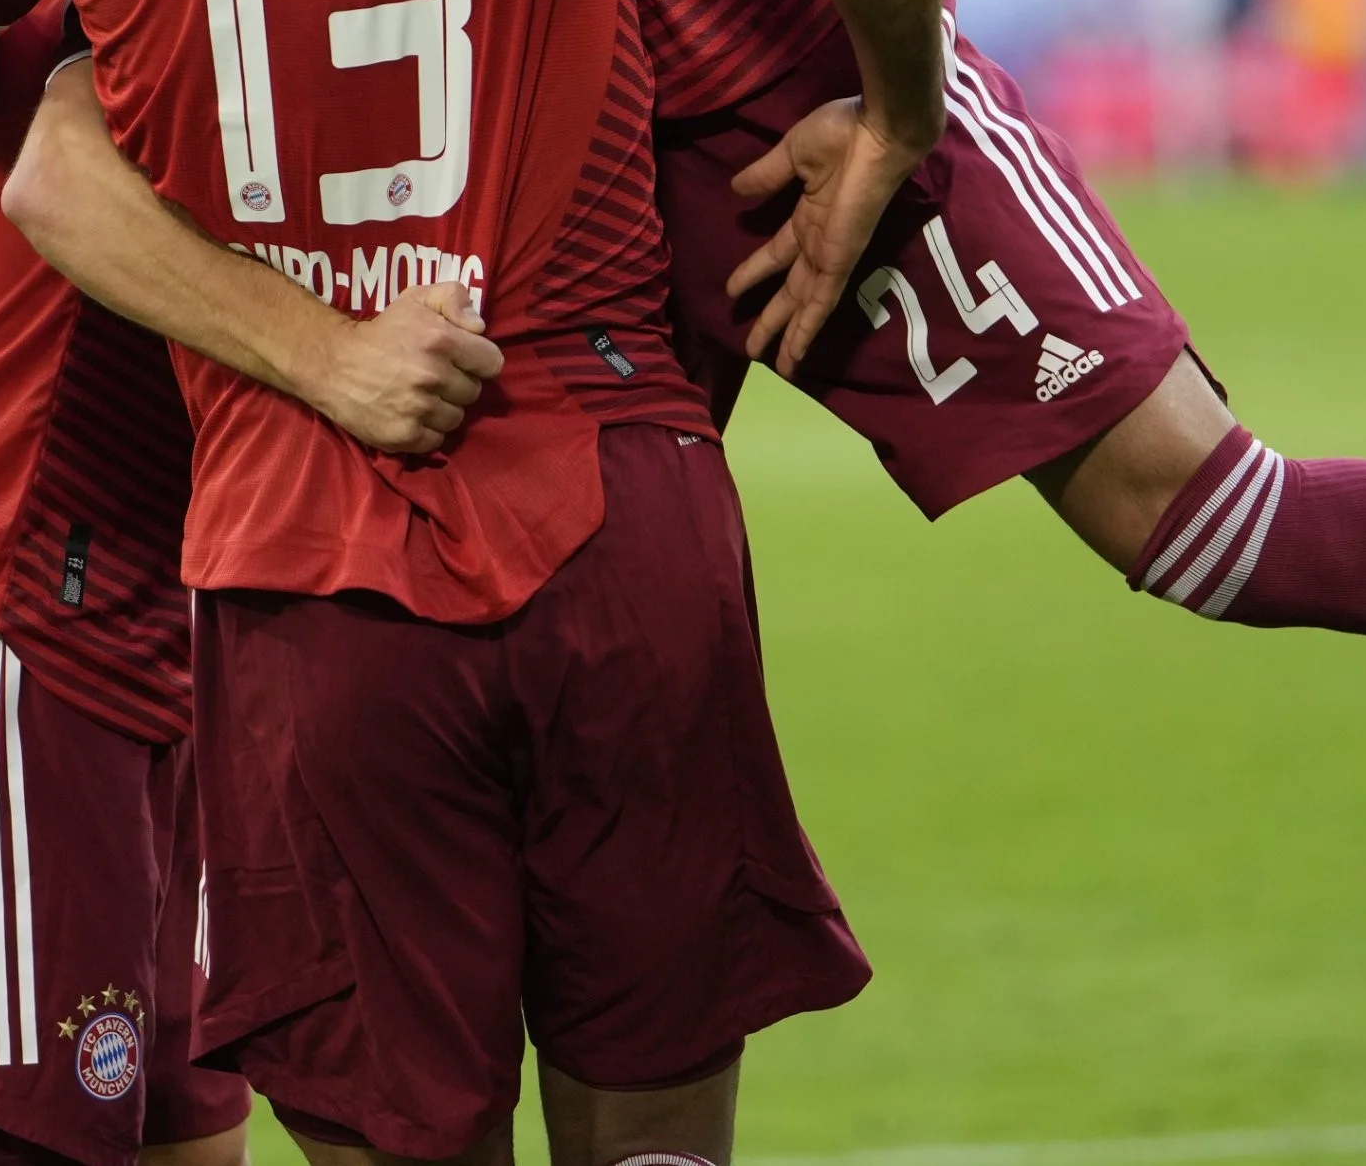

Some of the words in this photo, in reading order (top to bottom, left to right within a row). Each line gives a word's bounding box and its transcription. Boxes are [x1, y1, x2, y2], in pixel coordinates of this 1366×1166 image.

[856, 215, 1040, 407] 24
[1035, 349, 1105, 403] adidas
[82, 1033, 97, 1053] FC
[96, 1019, 136, 1049] BAYERN
[81, 1063, 136, 1095] MÜNCHEN
